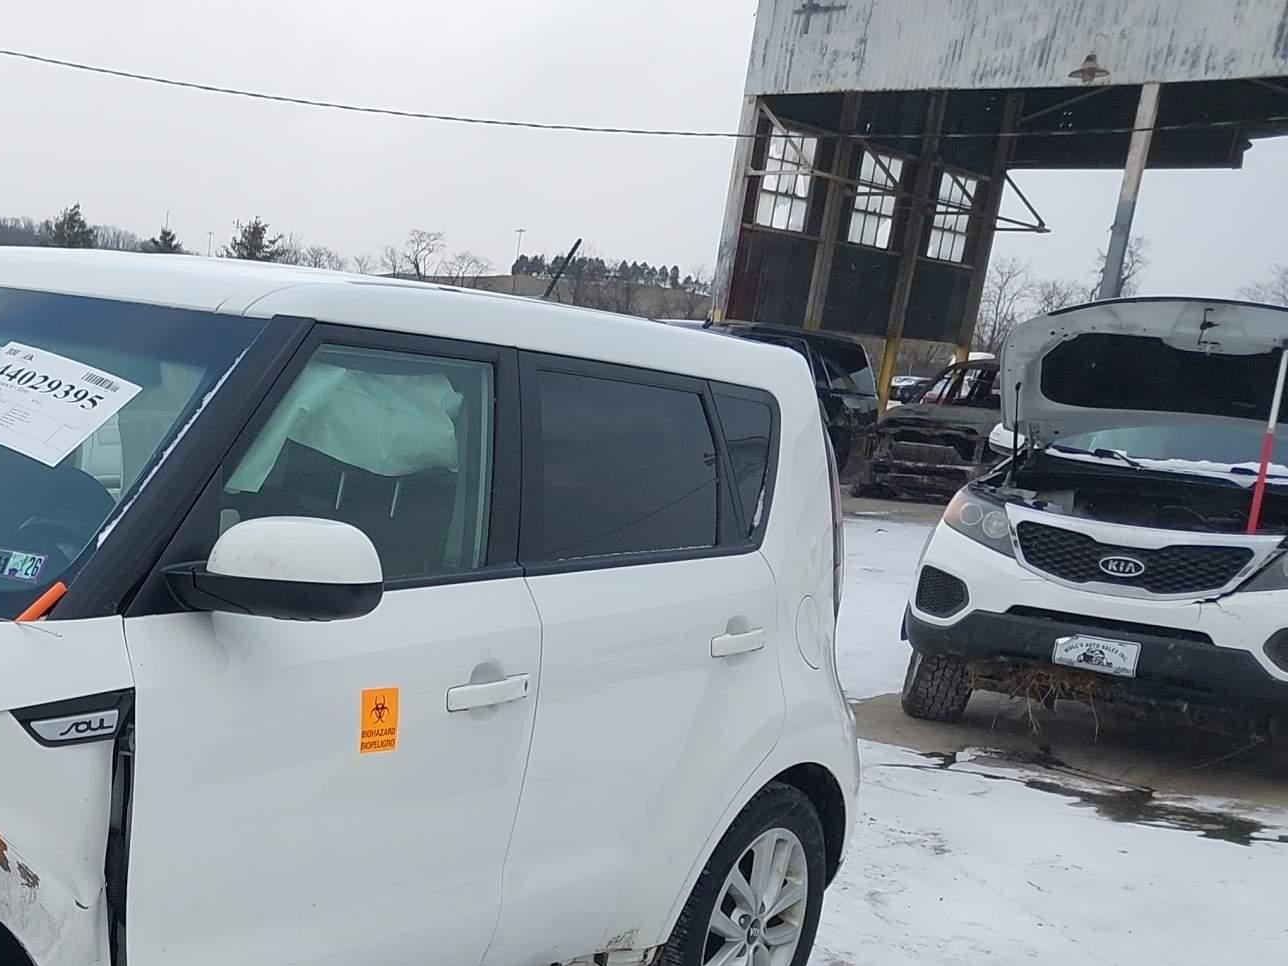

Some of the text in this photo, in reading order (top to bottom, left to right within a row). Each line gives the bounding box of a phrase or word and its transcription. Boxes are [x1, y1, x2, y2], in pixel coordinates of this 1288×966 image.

[24, 556, 43, 577] 26
[1107, 559, 1136, 573] KIA
[1101, 644, 1119, 655] SALES
[59, 718, 114, 737] SOUL
[361, 727, 396, 739] BIOHAZARD
[360, 738, 396, 751] BIOPELIGRO
